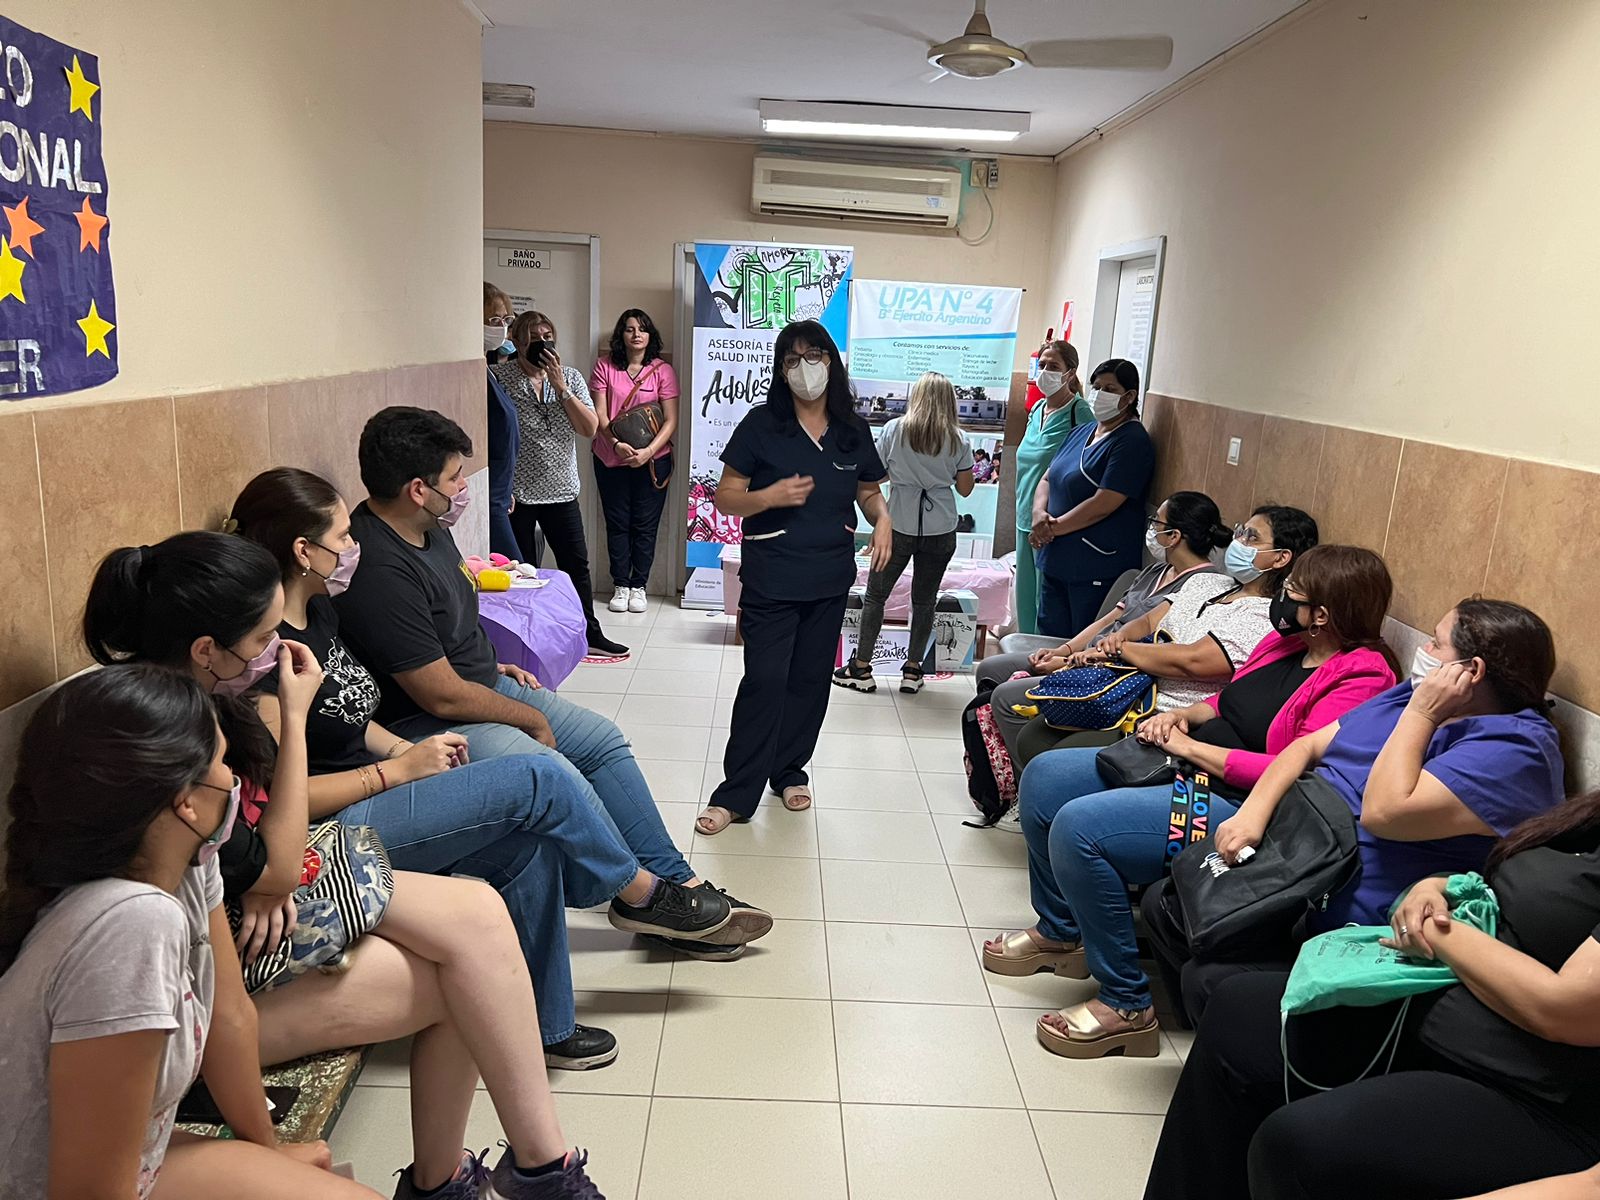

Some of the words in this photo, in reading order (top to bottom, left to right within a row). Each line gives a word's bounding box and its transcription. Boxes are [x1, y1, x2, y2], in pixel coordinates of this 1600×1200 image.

[513, 249, 536, 259] BAÑO
[507, 258, 542, 269] PRIVADO
[879, 286, 933, 311] UPA
[975, 291, 993, 314] 4
[934, 311, 992, 326] Argentino
[708, 338, 763, 351] ASESORÍA
[892, 341, 923, 350] Contamos
[707, 351, 744, 363] SALUD
[747, 353, 773, 365] INTE
[702, 369, 771, 418] Adoles
[1191, 791, 1210, 842] LOVE
